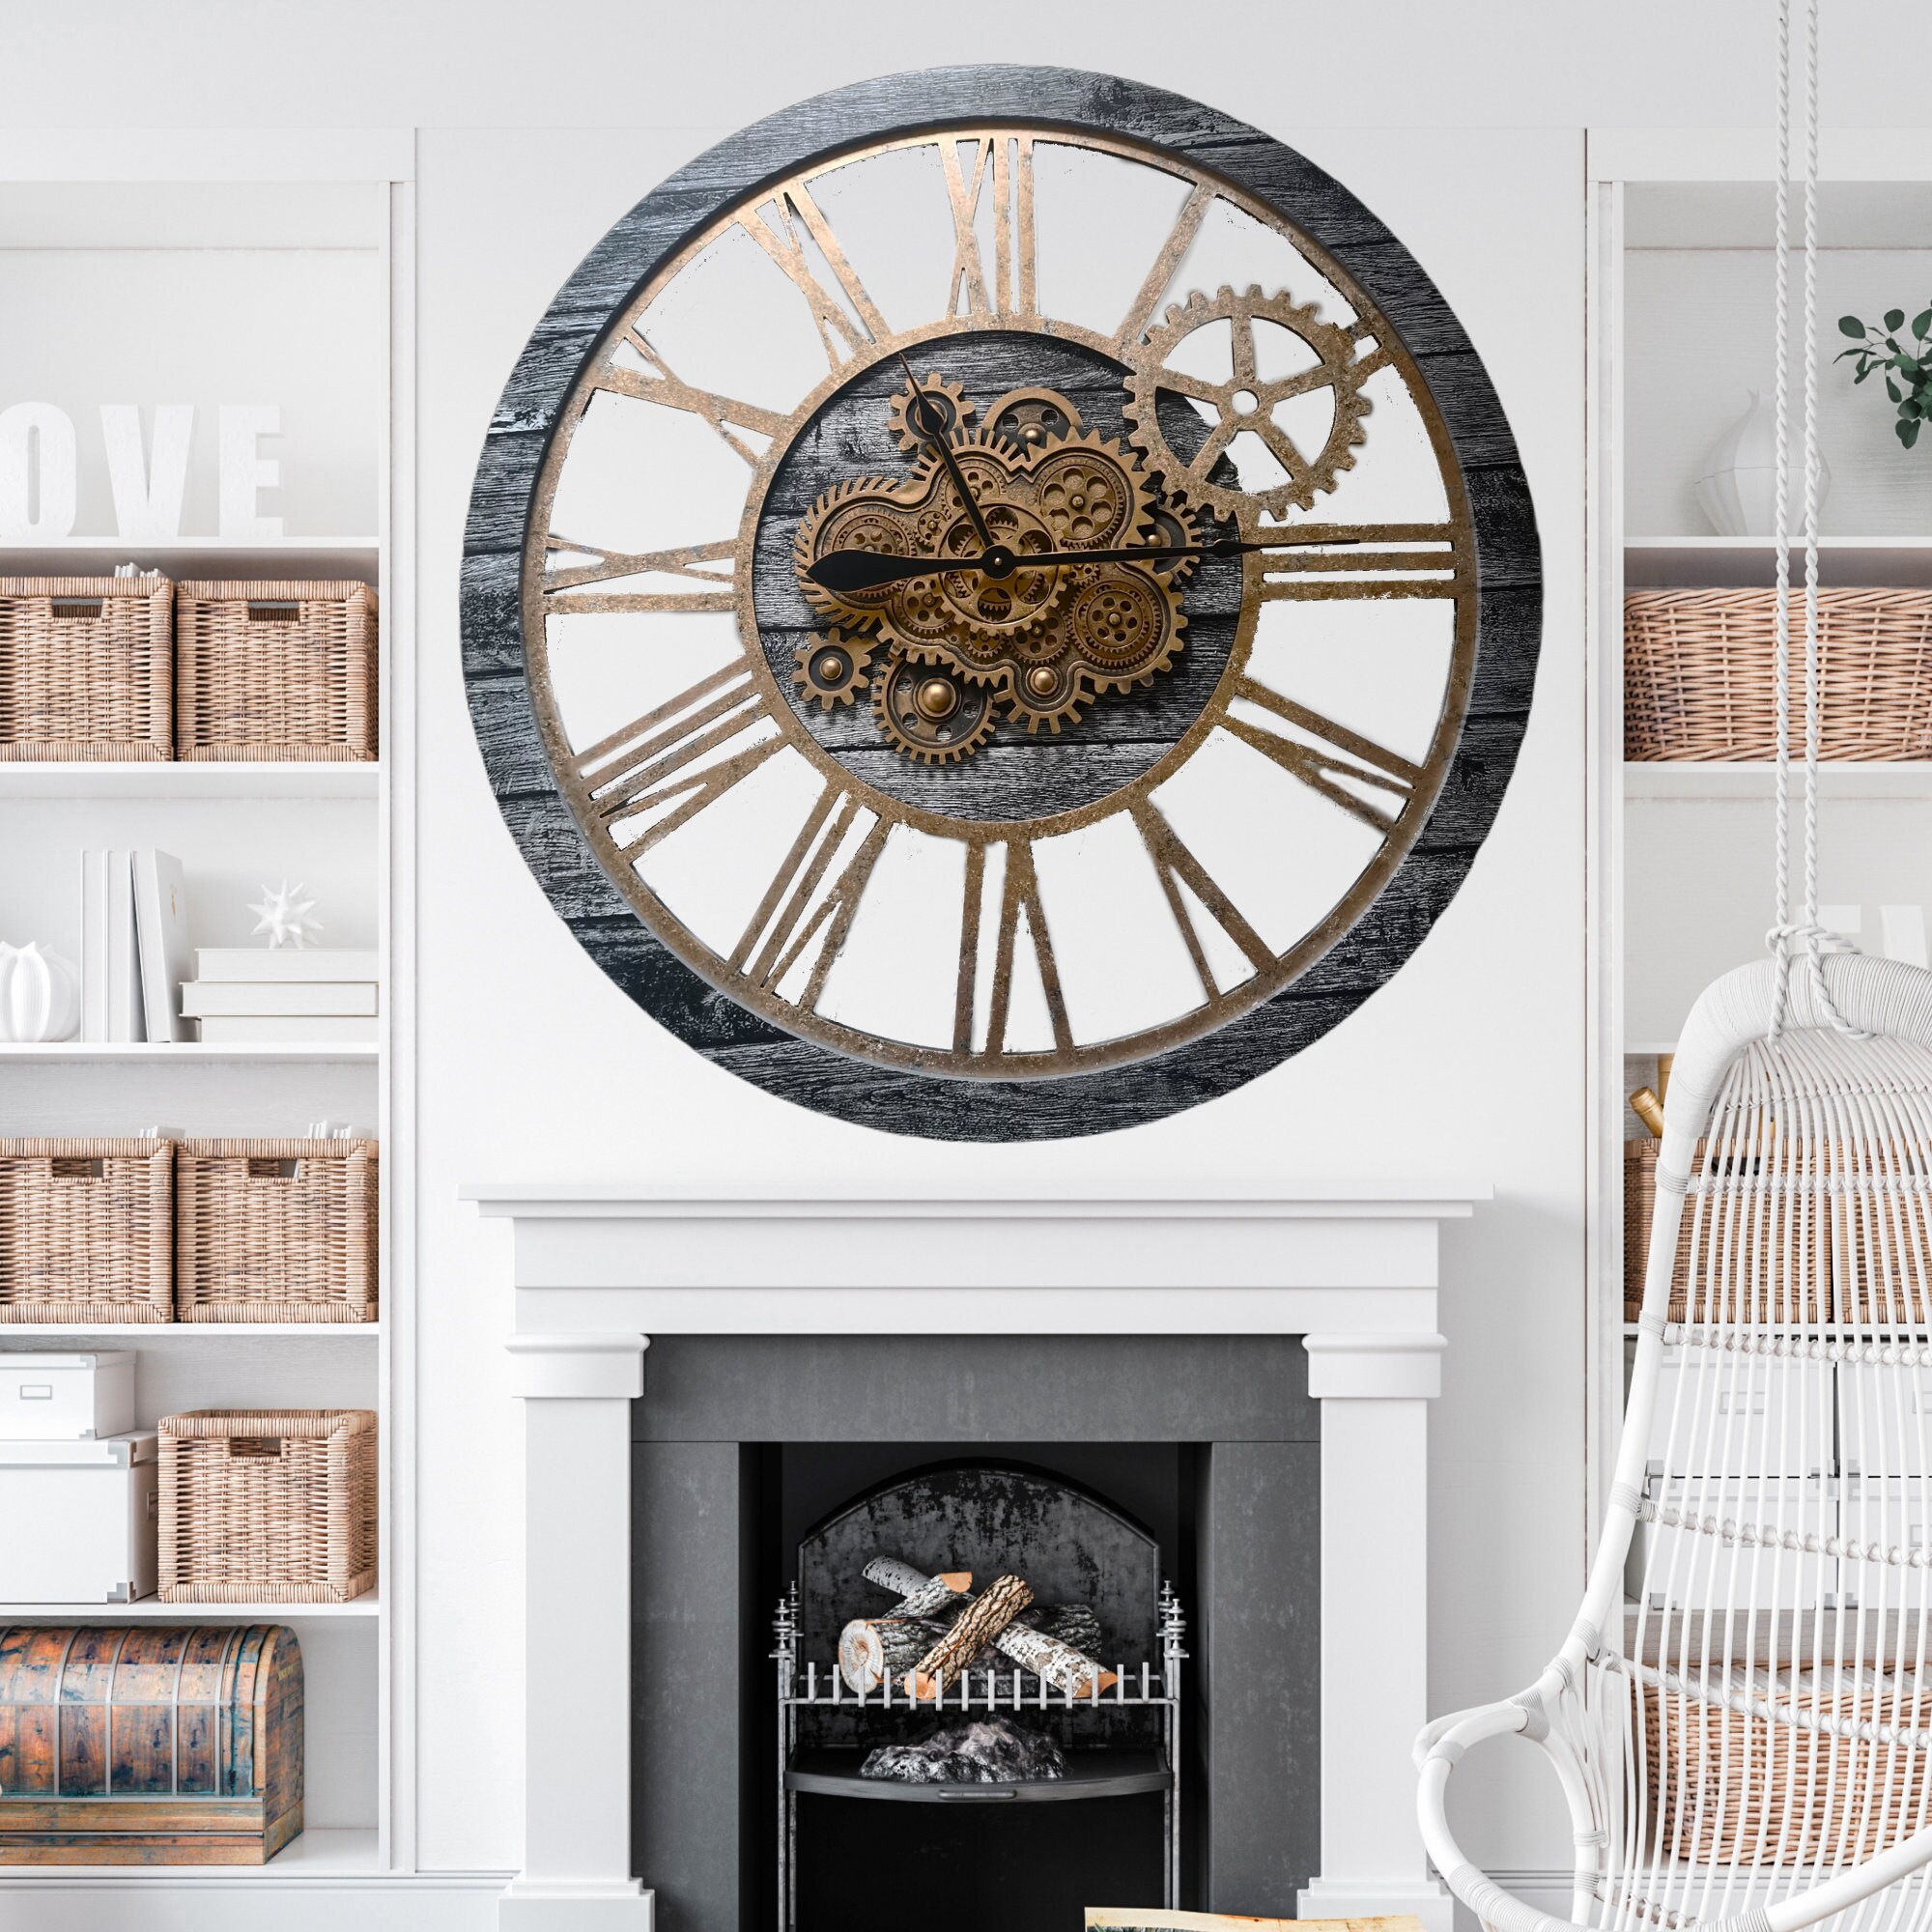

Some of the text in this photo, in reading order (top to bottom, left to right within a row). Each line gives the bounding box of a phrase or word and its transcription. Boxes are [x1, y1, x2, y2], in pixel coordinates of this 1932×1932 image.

[737, 182, 895, 374] XI
[936, 135, 1040, 319] XII
[1113, 183, 1217, 344] I
[0, 401, 283, 537] OVE
[583, 327, 796, 469] X
[542, 534, 738, 614] IX
[1258, 523, 1455, 601] III
[574, 653, 796, 865] VIII
[1215, 676, 1428, 838] IV
[725, 777, 895, 1014] VII
[951, 837, 1076, 1057] VI
[1126, 794, 1280, 1007] V
